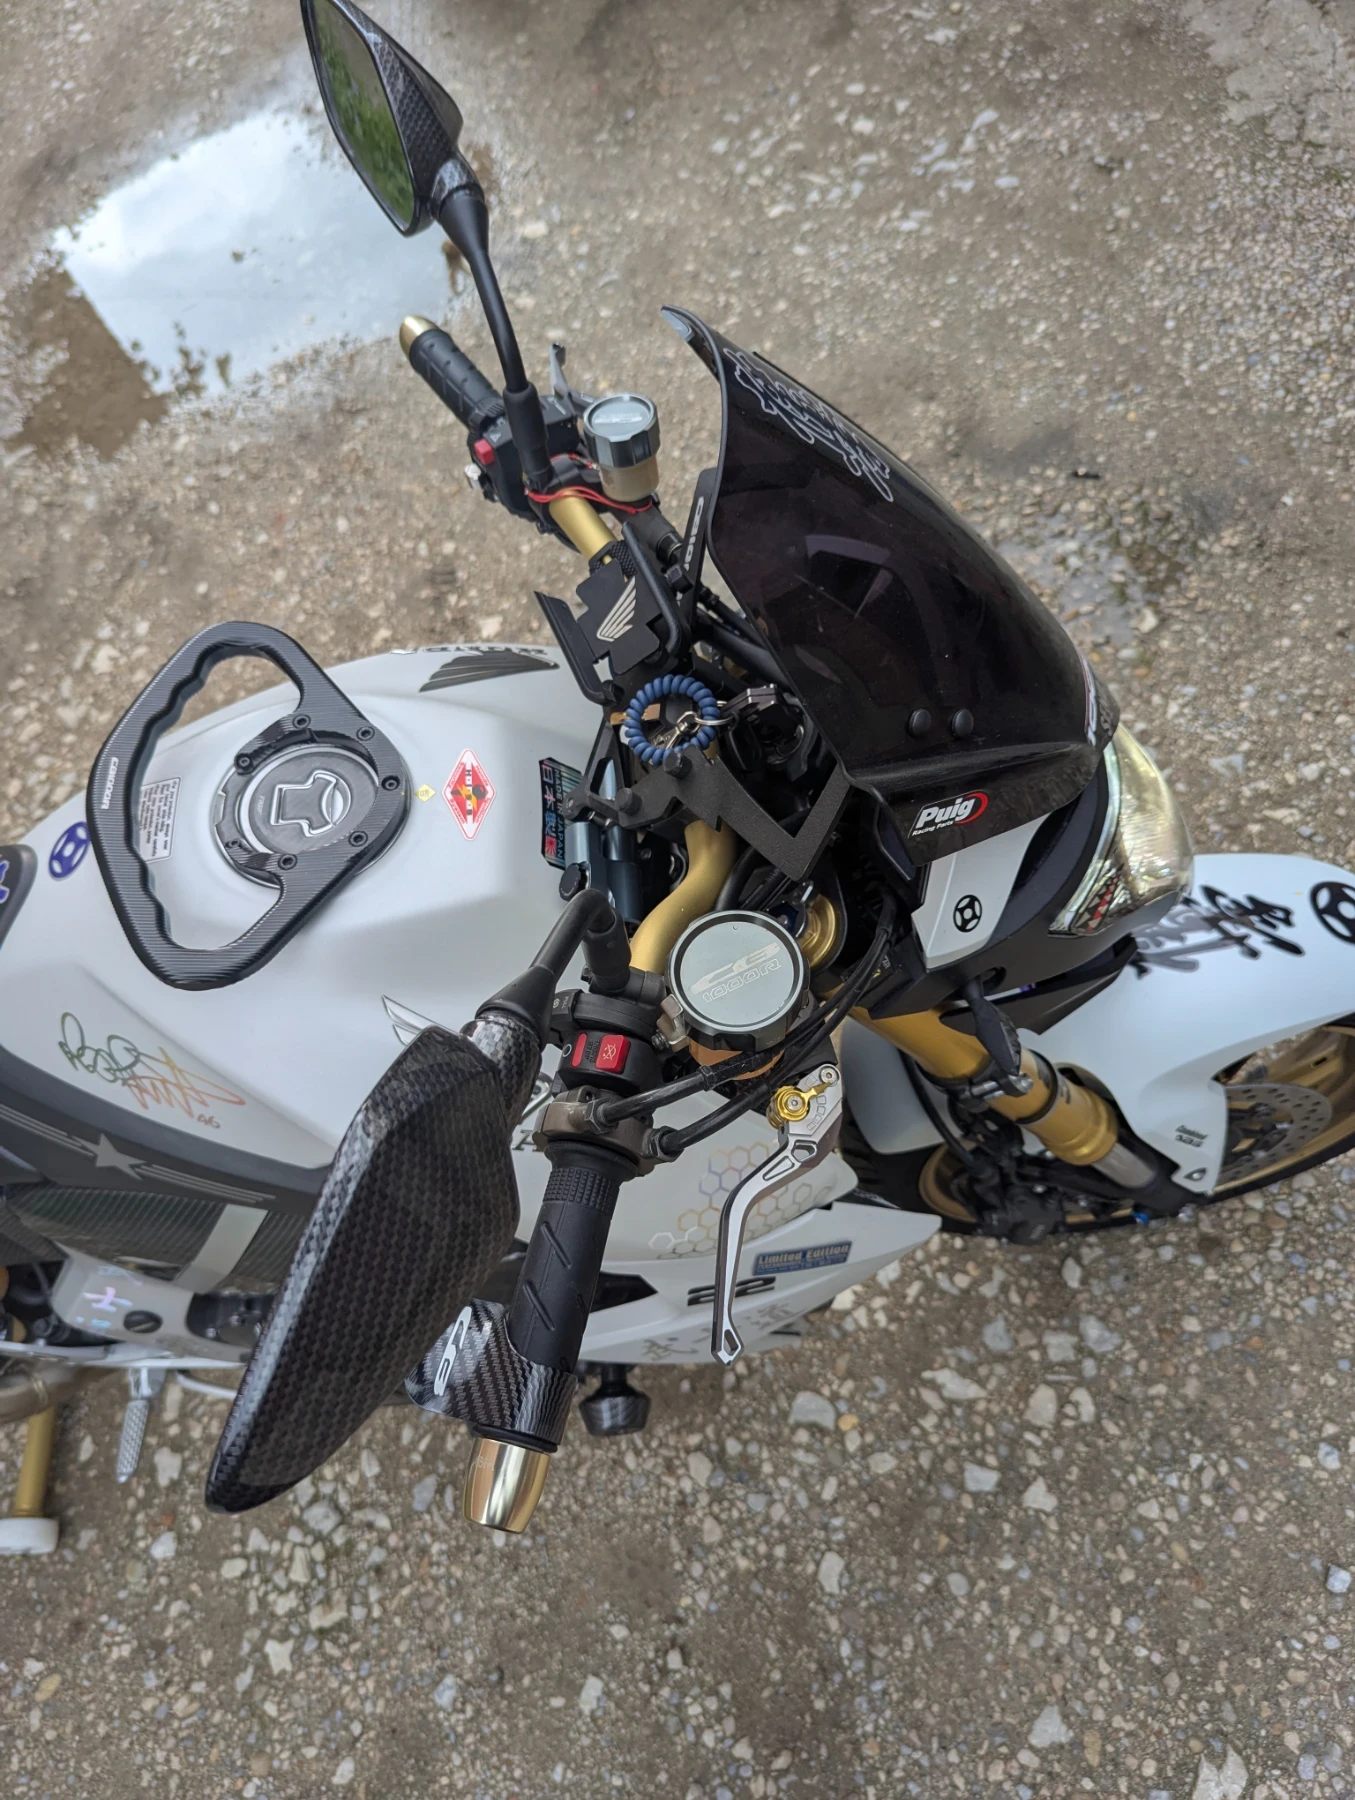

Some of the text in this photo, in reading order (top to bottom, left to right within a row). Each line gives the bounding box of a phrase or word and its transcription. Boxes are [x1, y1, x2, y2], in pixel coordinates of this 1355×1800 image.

[554, 769, 565, 858] MADE IN JAPAN
[911, 820, 954, 837] Racing Parts
[915, 797, 976, 829] Puig
[702, 958, 782, 1003] 1000R
[758, 1251, 803, 1265] Limited
[806, 1244, 850, 1259] Edition
[433, 1305, 473, 1397] CB
